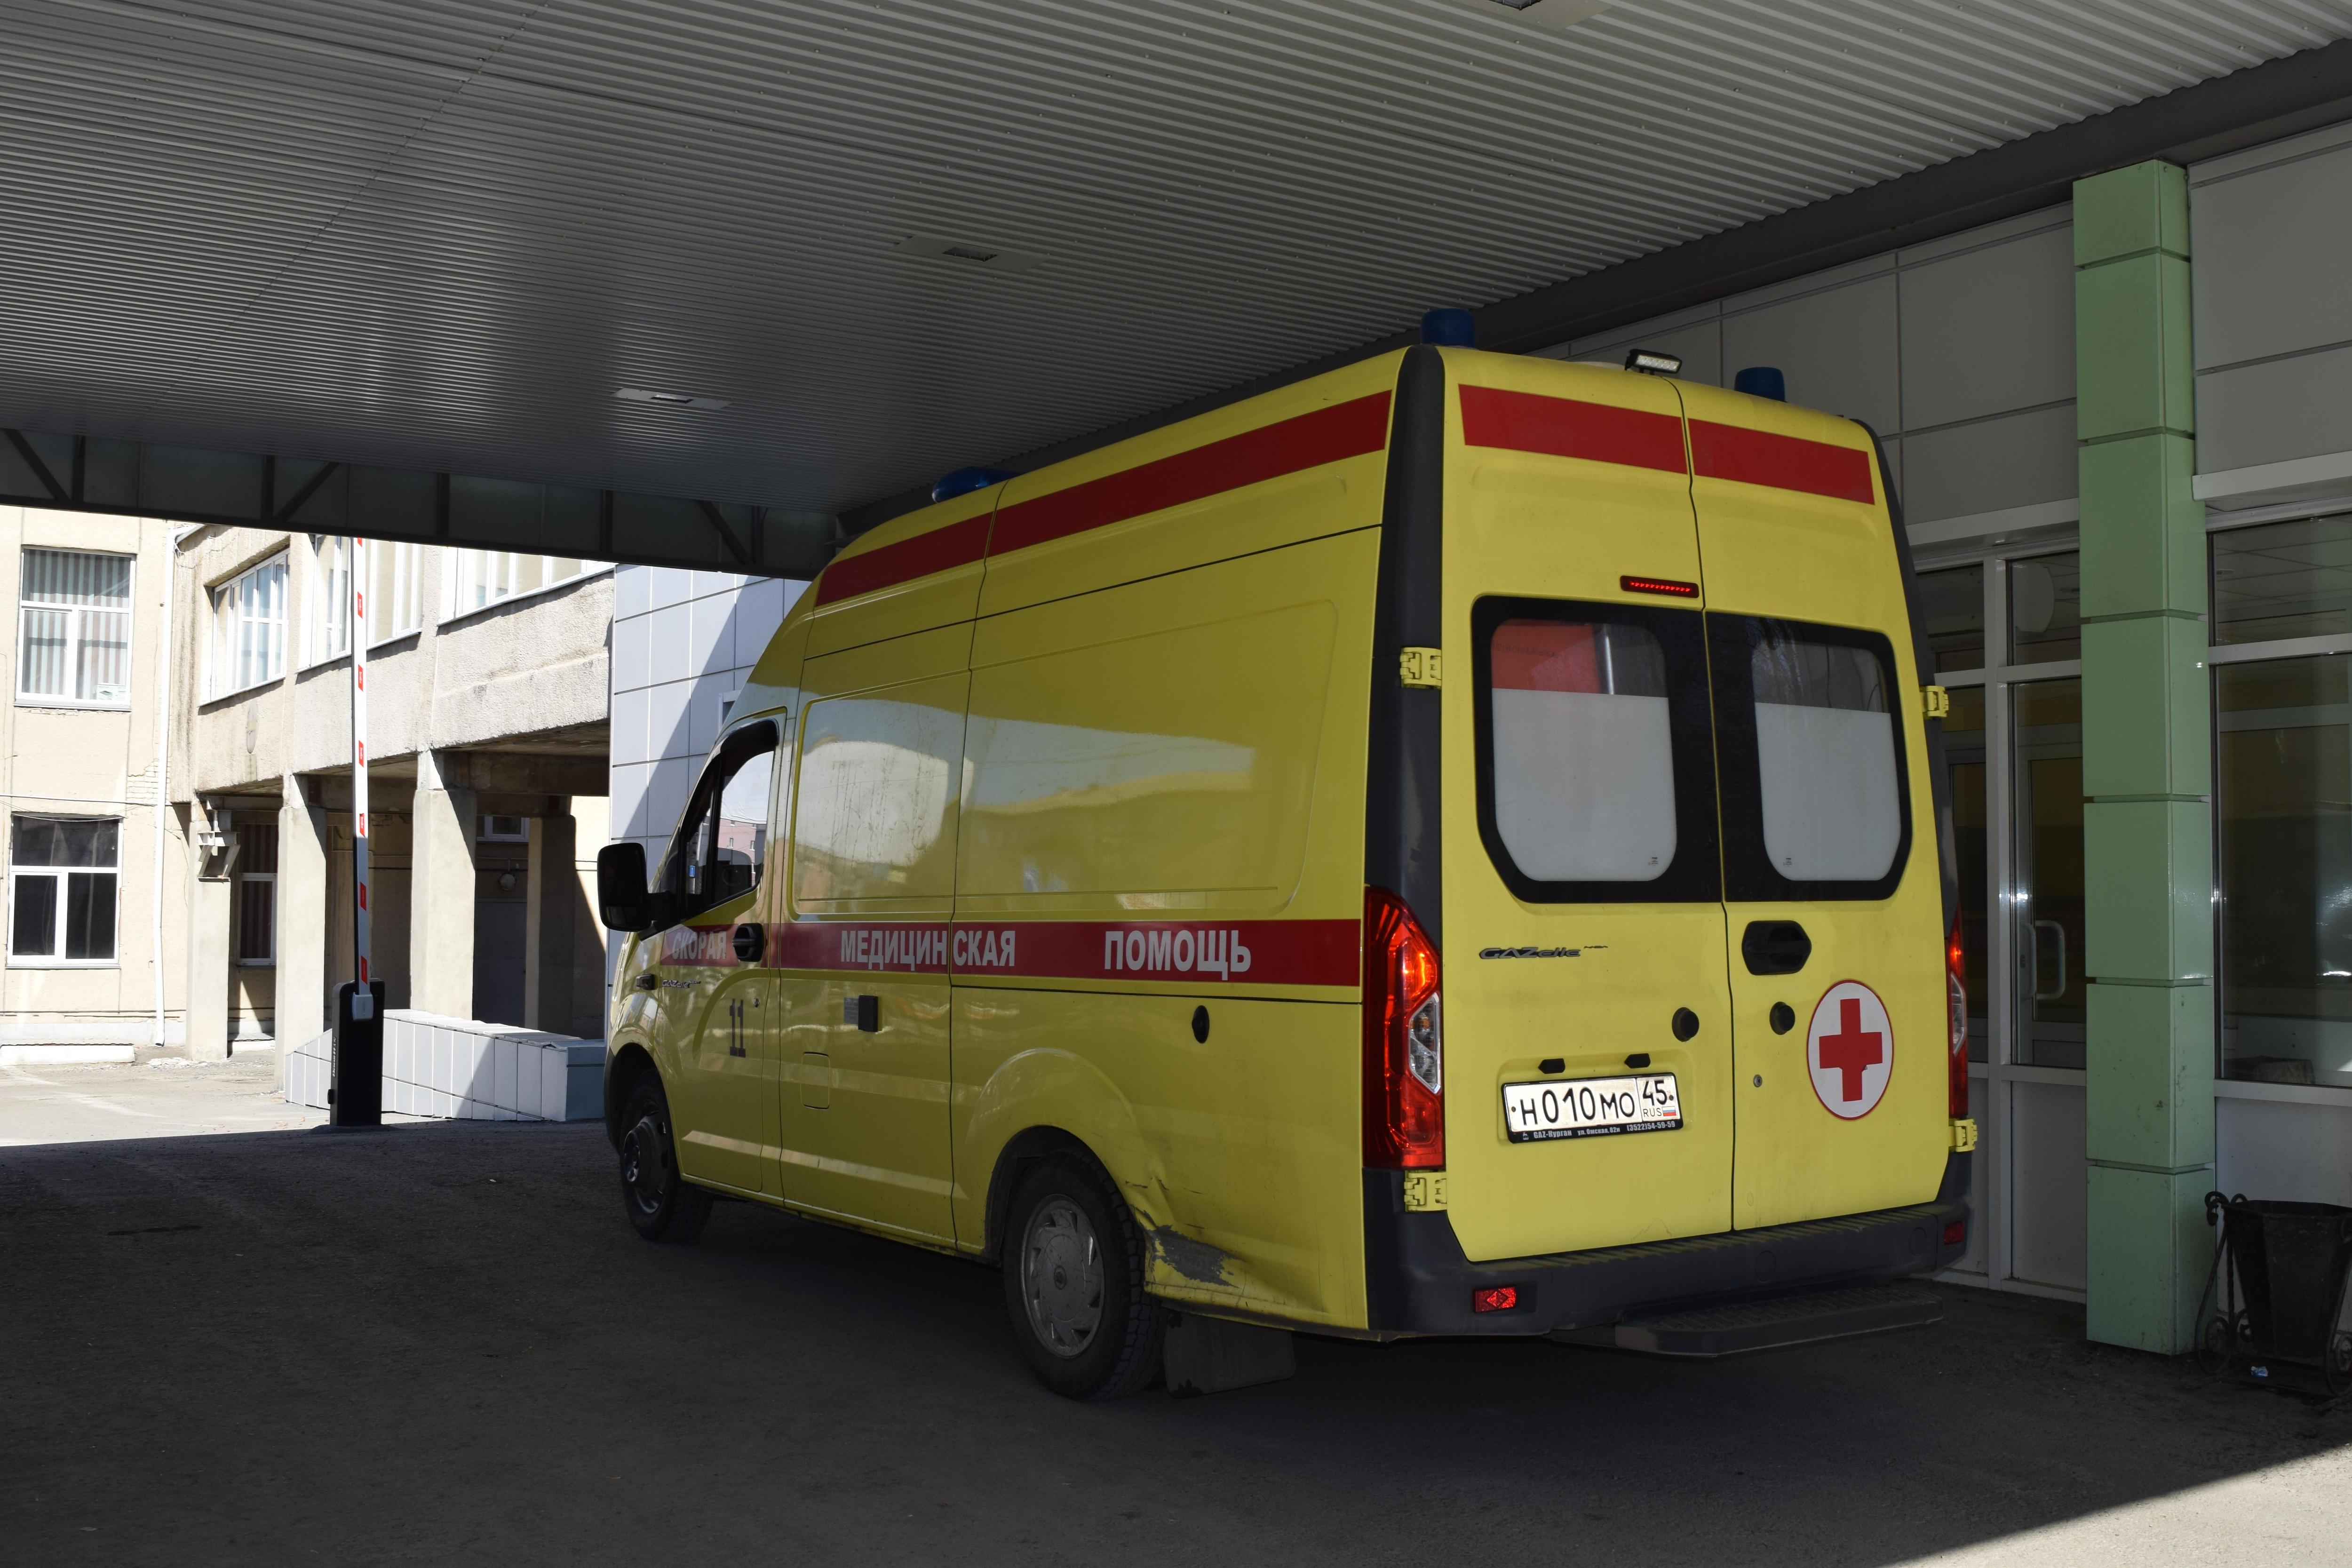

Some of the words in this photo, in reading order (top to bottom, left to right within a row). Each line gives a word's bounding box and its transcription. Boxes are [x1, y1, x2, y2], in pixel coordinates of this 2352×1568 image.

[672, 931, 727, 959] СКОРАЯ
[841, 930, 1016, 971] МЕДИЦИНСКАЯ
[1104, 930, 1251, 980] ПОМОЩЬ
[1479, 947, 1581, 959] GAZelle
[730, 998, 746, 1058] 11
[1642, 1080, 1668, 1106] 45
[1643, 1108, 1661, 1117] RUS
